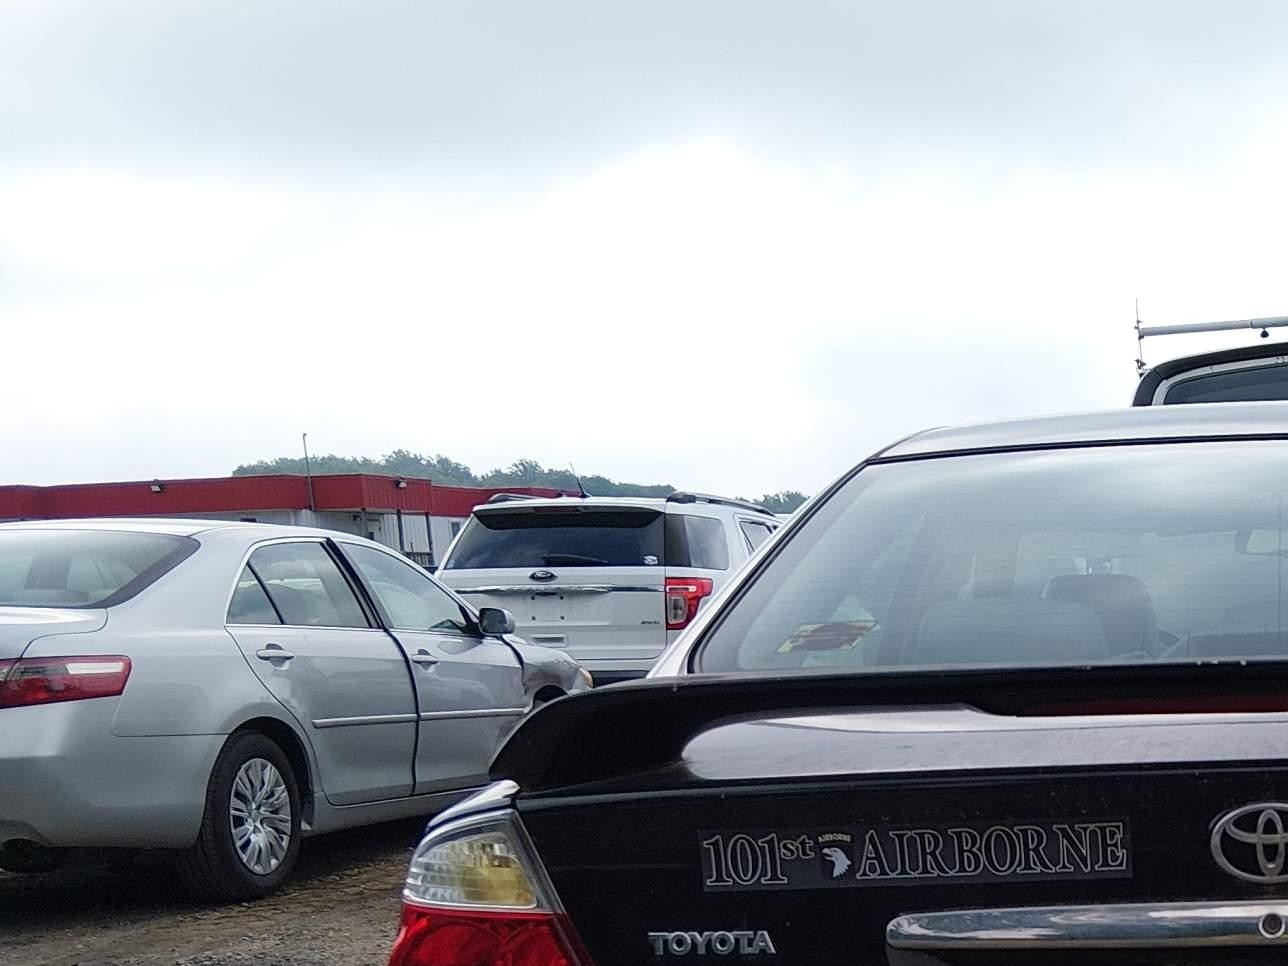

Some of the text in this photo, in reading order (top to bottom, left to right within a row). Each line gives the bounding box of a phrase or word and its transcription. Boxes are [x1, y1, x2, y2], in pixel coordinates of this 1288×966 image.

[703, 822, 1127, 886] 101st AIRBORNE
[647, 930, 777, 955] TOYOTA
